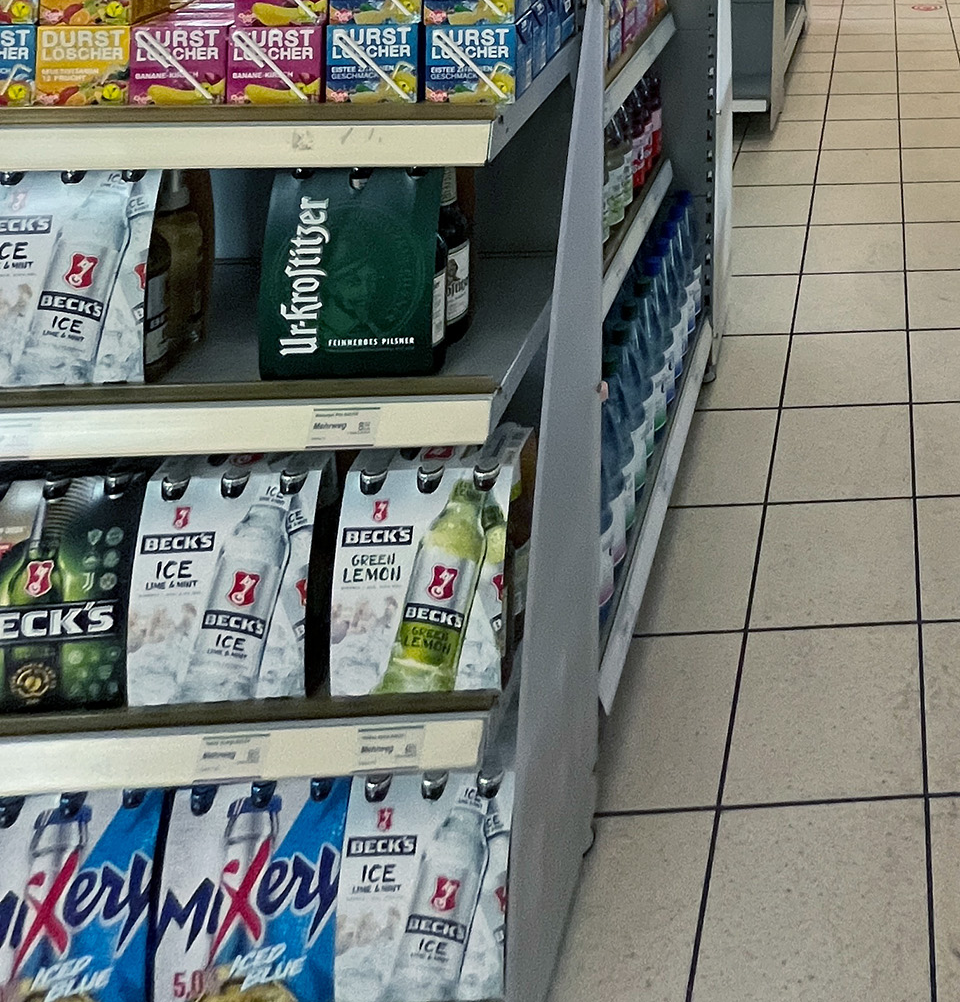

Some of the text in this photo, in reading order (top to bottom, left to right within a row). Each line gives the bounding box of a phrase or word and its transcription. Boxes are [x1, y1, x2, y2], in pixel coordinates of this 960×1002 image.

[42, 29, 125, 48] DURST
[0, 242, 29, 260] CE
[40, 294, 104, 318] BECK'S
[51, 315, 83, 334] ICE
[328, 337, 415, 347] FEINHERBES PILSNER
[313, 422, 347, 430] Mehrweg
[144, 534, 213, 551] BECK'S
[345, 527, 411, 544] BECK'S
[351, 553, 396, 567] GREEN
[156, 560, 193, 579] ICE
[343, 566, 401, 584] LEMON
[145, 581, 166, 591] LIME
[176, 580, 198, 589] MINT
[0, 602, 114, 639] ECK'S
[204, 613, 264, 635] BECK'S
[405, 606, 464, 628] BECK'S
[215, 634, 246, 651] ICE
[404, 637, 452, 655] LEMON
[350, 837, 415, 855] BECK'S
[362, 864, 396, 883] ICE
[418, 938, 448, 955] ICE
[228, 942, 287, 978] ICED
[31, 955, 93, 991] ICED
[240, 956, 306, 991] BLUE
[44, 967, 113, 1001] BLUE
